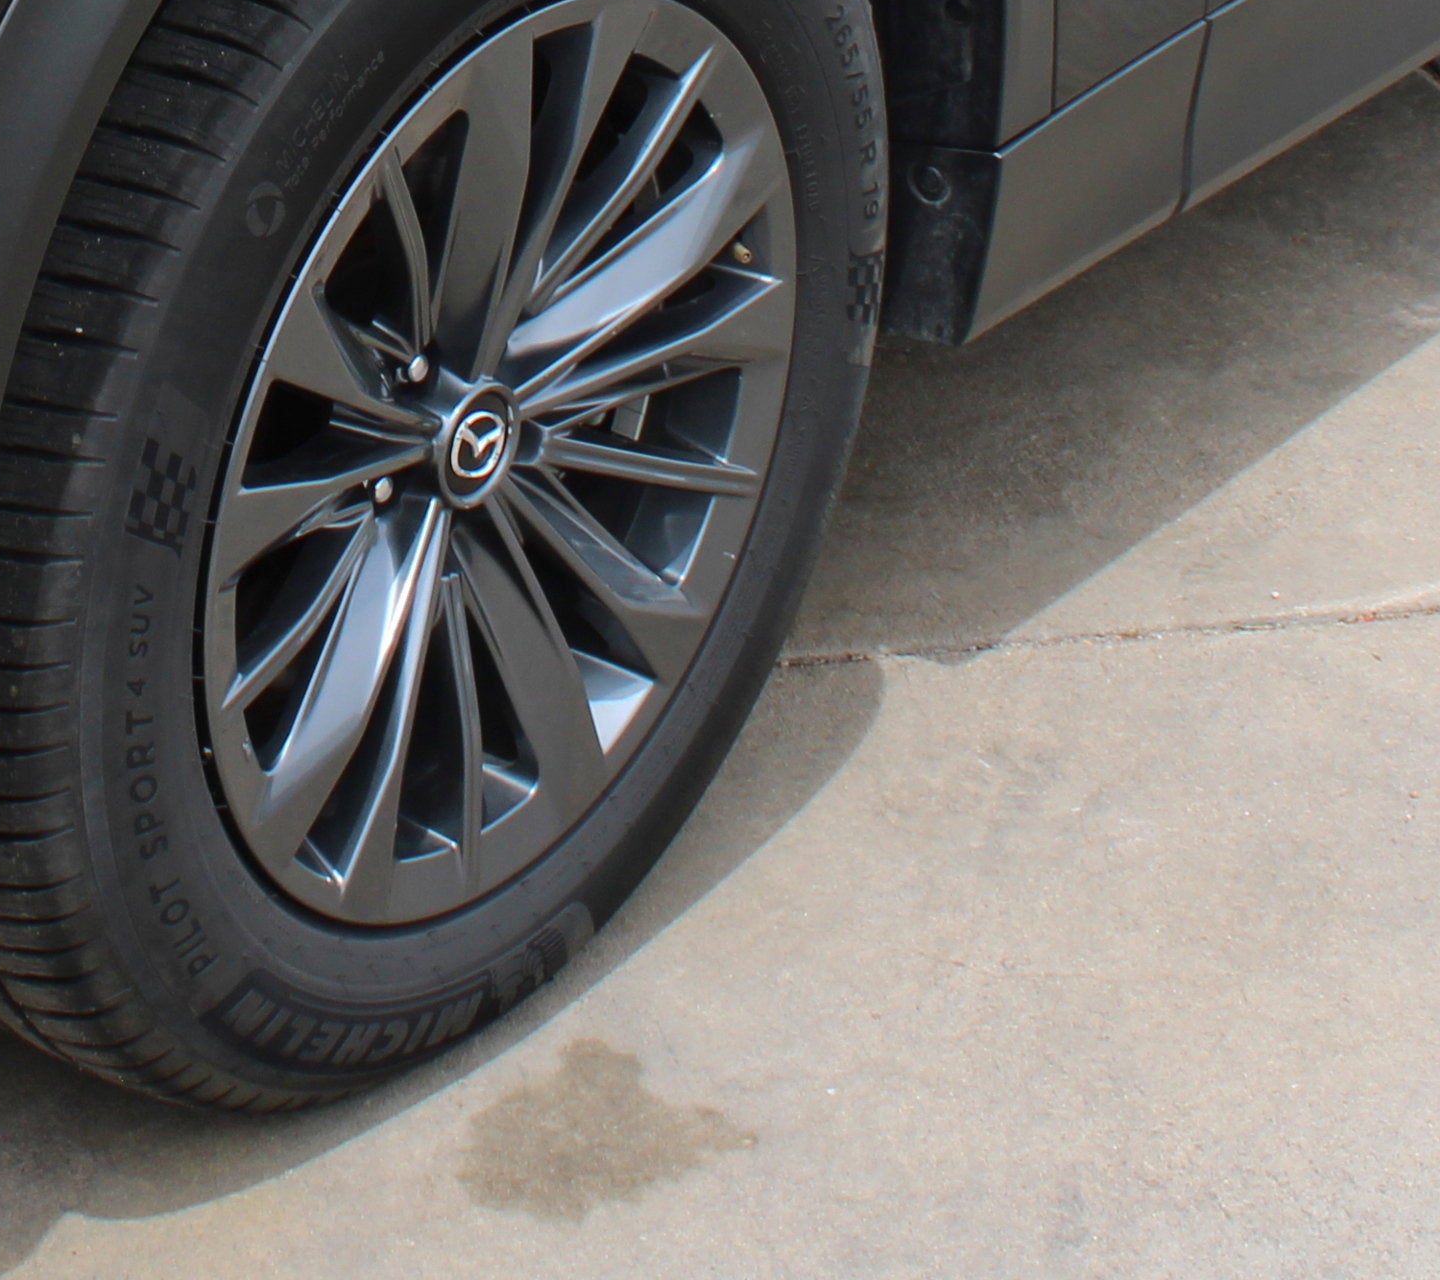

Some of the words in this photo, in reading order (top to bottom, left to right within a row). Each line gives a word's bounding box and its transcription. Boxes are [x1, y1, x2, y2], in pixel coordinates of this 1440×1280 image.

[822, 4, 874, 130] 265/55
[275, 62, 352, 175] MICHELIN
[858, 140, 878, 169] R
[860, 182, 881, 221] 19
[128, 583, 154, 658] SUV
[127, 678, 145, 701] 4
[126, 708, 170, 865] SPORT
[149, 880, 220, 980] PILOT
[223, 988, 485, 1066] MICHELIN
